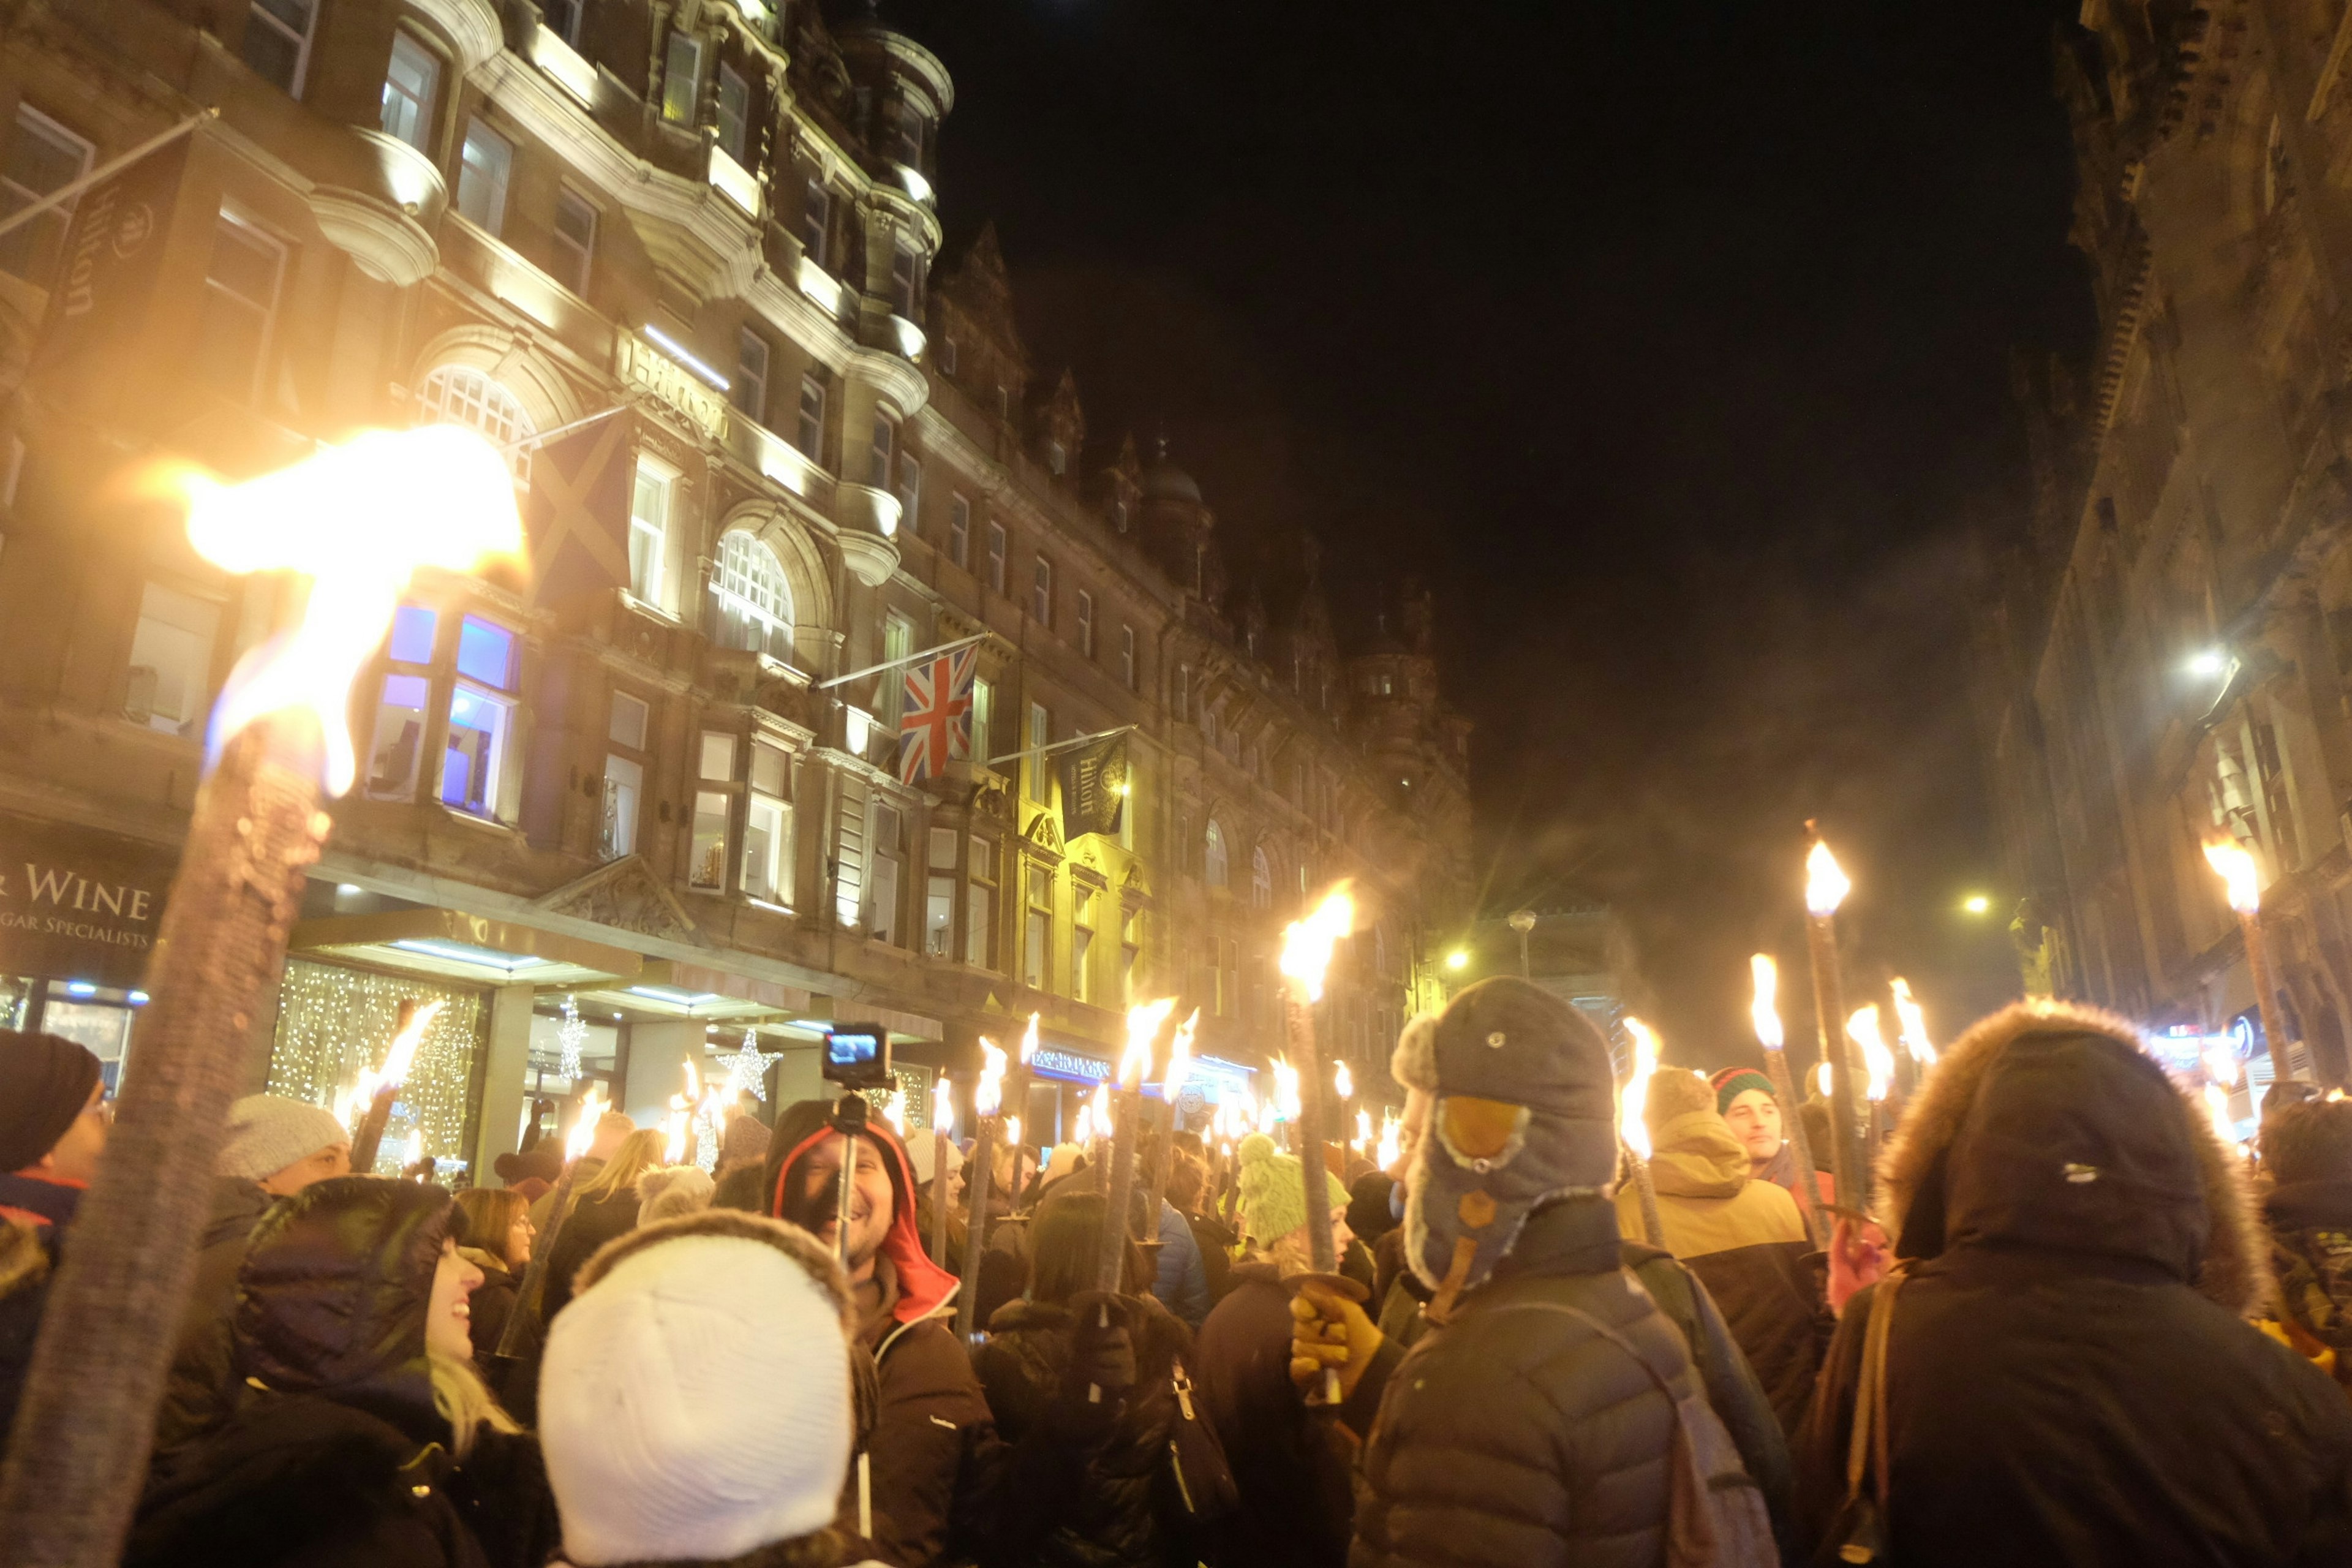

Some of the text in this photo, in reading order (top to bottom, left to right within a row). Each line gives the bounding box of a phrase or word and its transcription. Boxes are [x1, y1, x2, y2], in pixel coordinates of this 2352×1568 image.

[631, 337, 727, 439] Hilton
[1080, 757, 1098, 816] Hilton
[26, 863, 151, 920] WINE
[44, 917, 149, 947] SPECIALISTS
